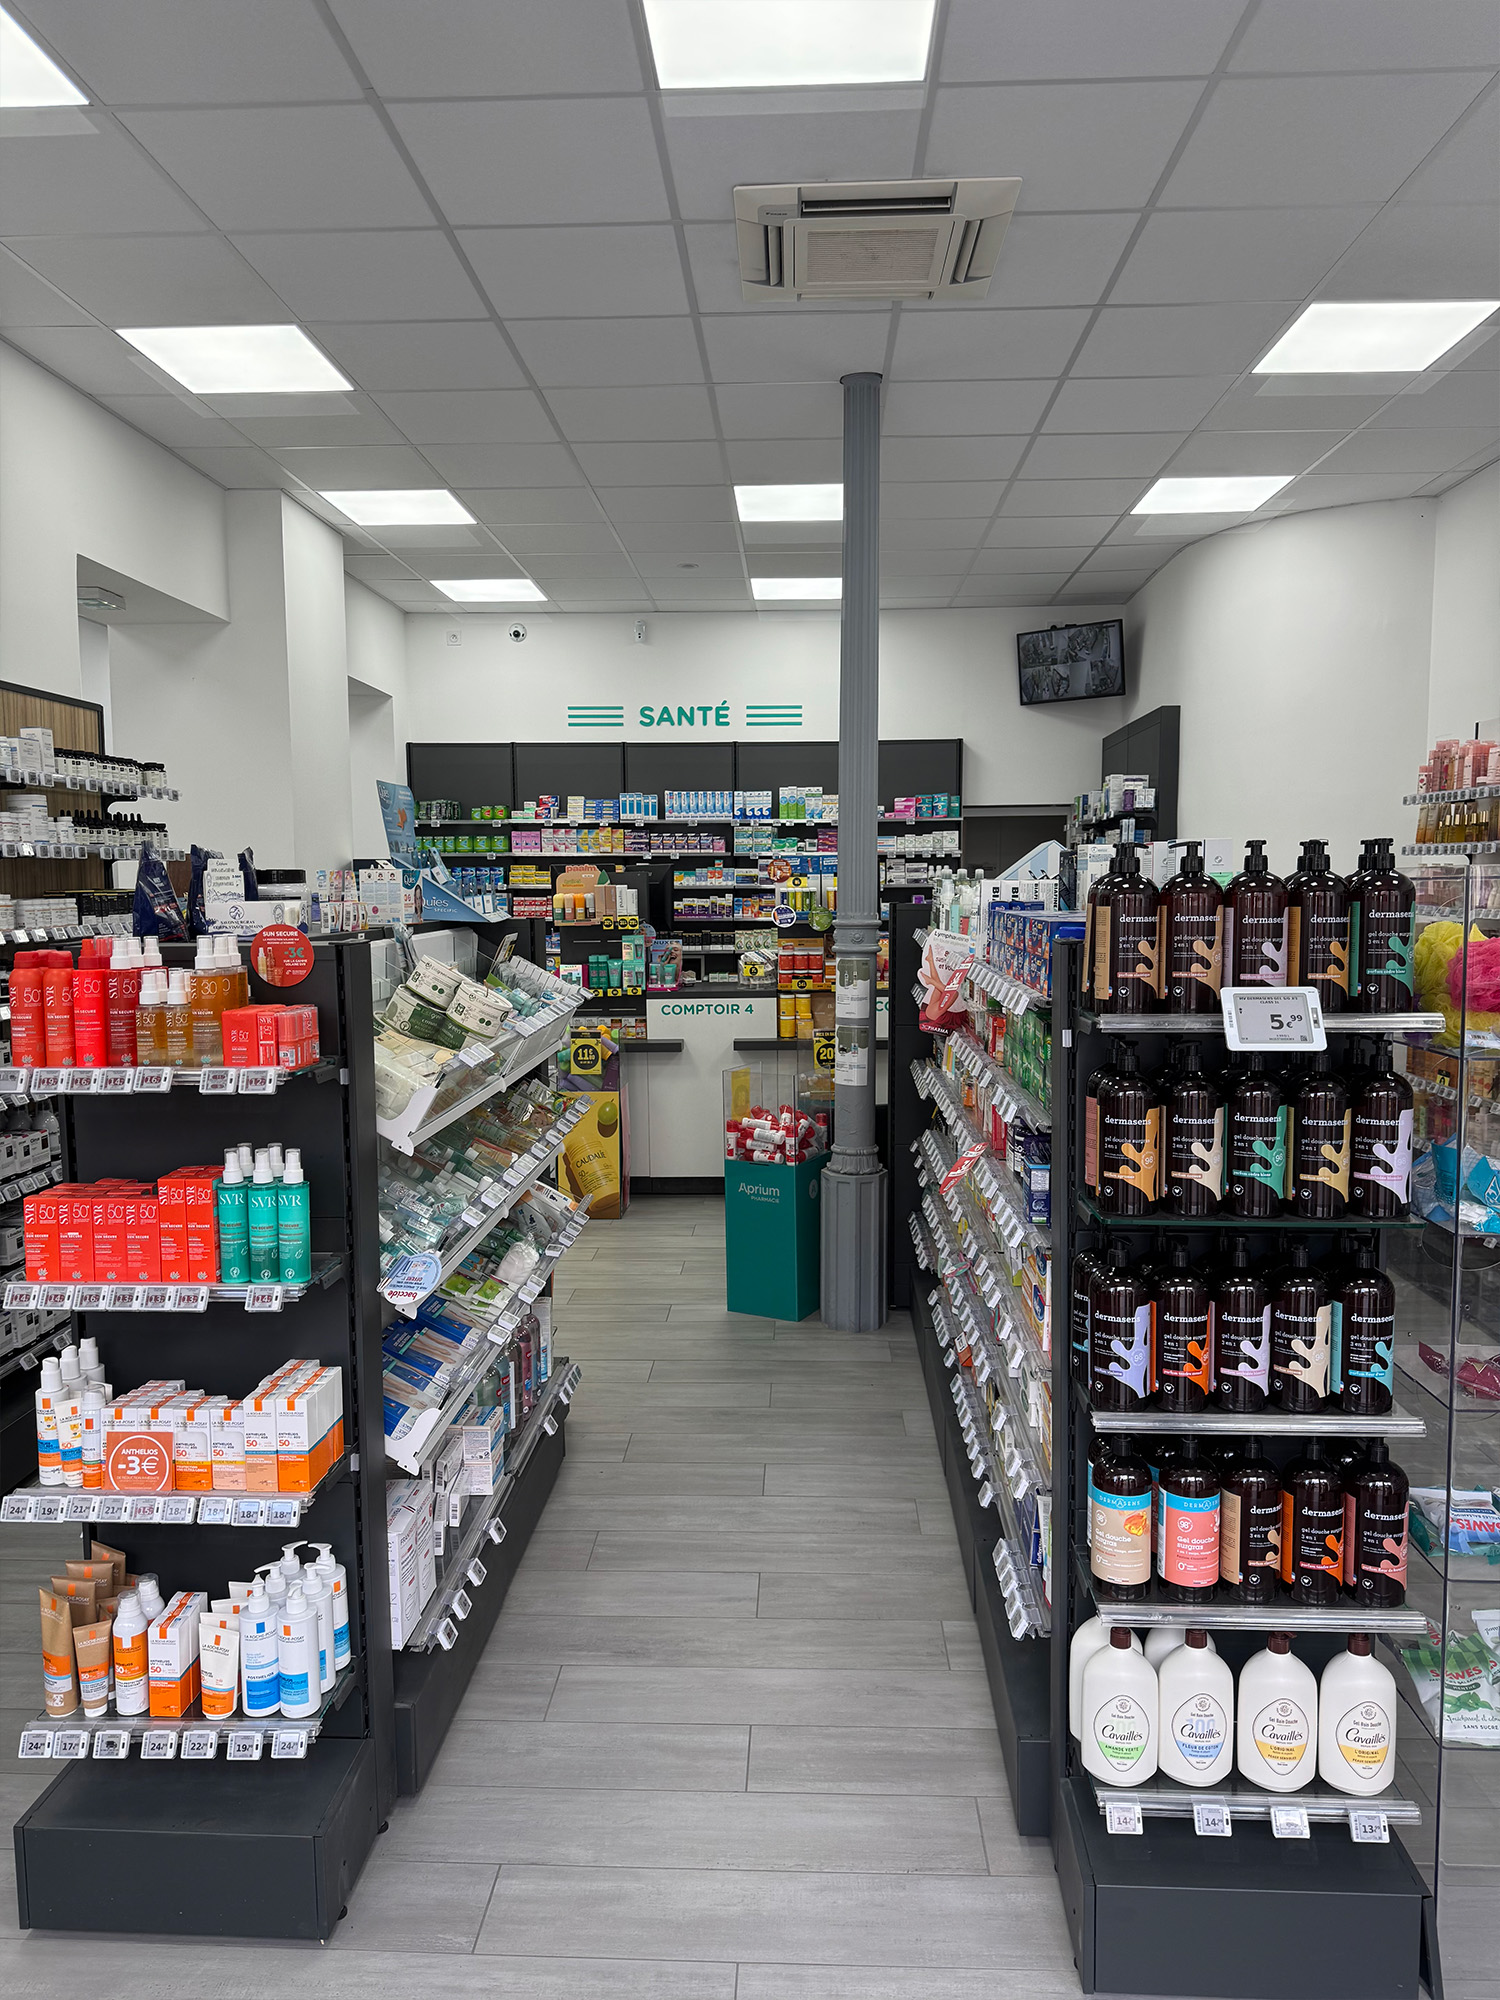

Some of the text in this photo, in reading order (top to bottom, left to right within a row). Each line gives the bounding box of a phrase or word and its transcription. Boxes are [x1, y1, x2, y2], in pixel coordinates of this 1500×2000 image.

[639, 700, 730, 727] SANTÉ
[284, 947, 305, 958] -3€
[108, 978, 118, 999] SVR
[46, 986, 55, 1007] SVR
[661, 1004, 754, 1015] COMPTOIR 4
[1105, 1115, 1151, 1125] dermasens
[1234, 1113, 1282, 1123] dermasens
[1355, 1115, 1404, 1126] dermasens
[575, 1150, 607, 1169] CAUDALIE
[159, 1186, 168, 1205] SVR
[186, 1186, 195, 1205] SVR
[738, 1182, 780, 1197] Aprium
[220, 1193, 245, 1206] SVR
[251, 1196, 277, 1208] SVR
[278, 1195, 302, 1207] SVR
[25, 1203, 35, 1225] SVR
[59, 1204, 68, 1225] SVR
[94, 1204, 103, 1225] SVR
[126, 1204, 136, 1226] SVR
[388, 1290, 417, 1300] baccide
[1094, 1311, 1140, 1323] dermasens
[117, 1456, 159, 1476] -3€
[1456, 1519, 1495, 1533] SAWES
[1177, 1543, 1204, 1551] surgras
[1191, 1536, 1215, 1545] douche
